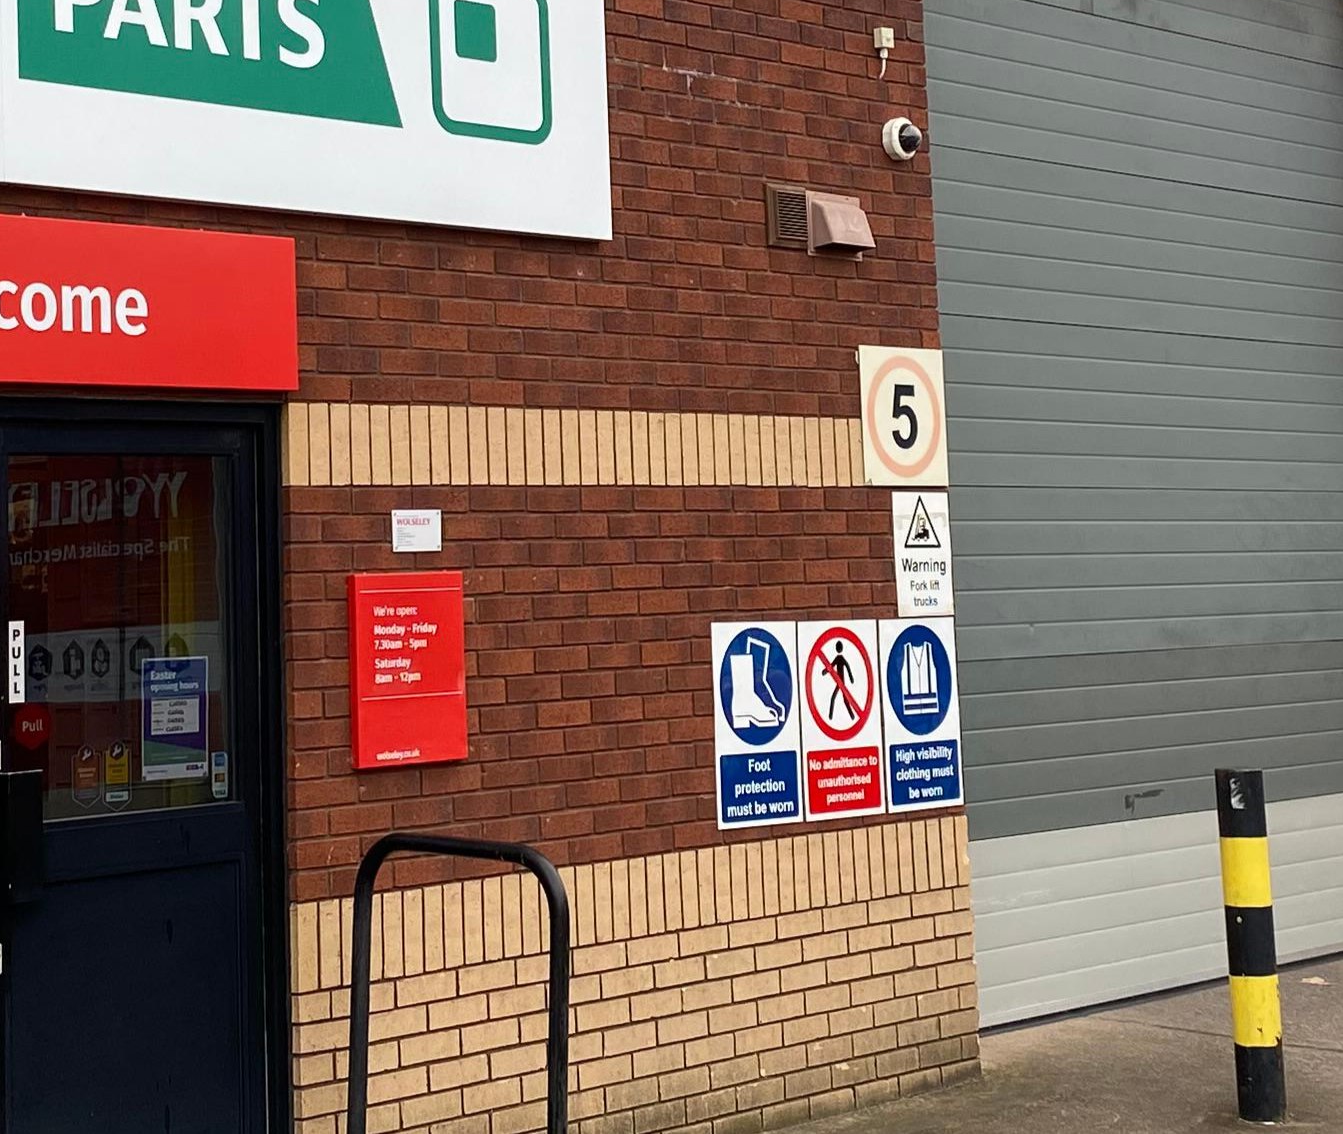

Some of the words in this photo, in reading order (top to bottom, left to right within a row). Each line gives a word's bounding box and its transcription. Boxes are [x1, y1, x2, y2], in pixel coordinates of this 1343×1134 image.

[892, 384, 918, 450] 5
[902, 558, 947, 576] Warning
[910, 580, 927, 591] Fork
[929, 580, 940, 590] lift
[913, 596, 939, 607] trucks
[373, 605, 395, 616] We're
[396, 606, 417, 616] open:
[374, 625, 405, 636] Monday
[412, 622, 437, 634] Friday
[374, 639, 402, 650] 7.30am
[409, 638, 427, 649] 5pm
[12, 629, 21, 694] PULL
[375, 657, 411, 669] Saturday
[151, 670, 176, 680] Easter
[375, 673, 393, 683] 8am
[399, 671, 421, 683] 12pm
[151, 681, 178, 692] opening
[179, 680, 199, 689] hours
[22, 719, 43, 732] Pull
[895, 749, 916, 764] High
[917, 745, 953, 761] visibility
[748, 759, 771, 773] Foot
[809, 759, 822, 771] No
[823, 756, 867, 770] admittance
[868, 756, 878, 766] to
[896, 767, 931, 782] clothing
[932, 765, 954, 777] must
[734, 779, 786, 797] protection
[817, 773, 872, 789] unauthorised
[826, 790, 865, 806] personnel
[908, 786, 920, 799] be
[921, 786, 943, 797] worn
[727, 804, 753, 817] must
[754, 803, 768, 815] be
[768, 801, 794, 813] worn
